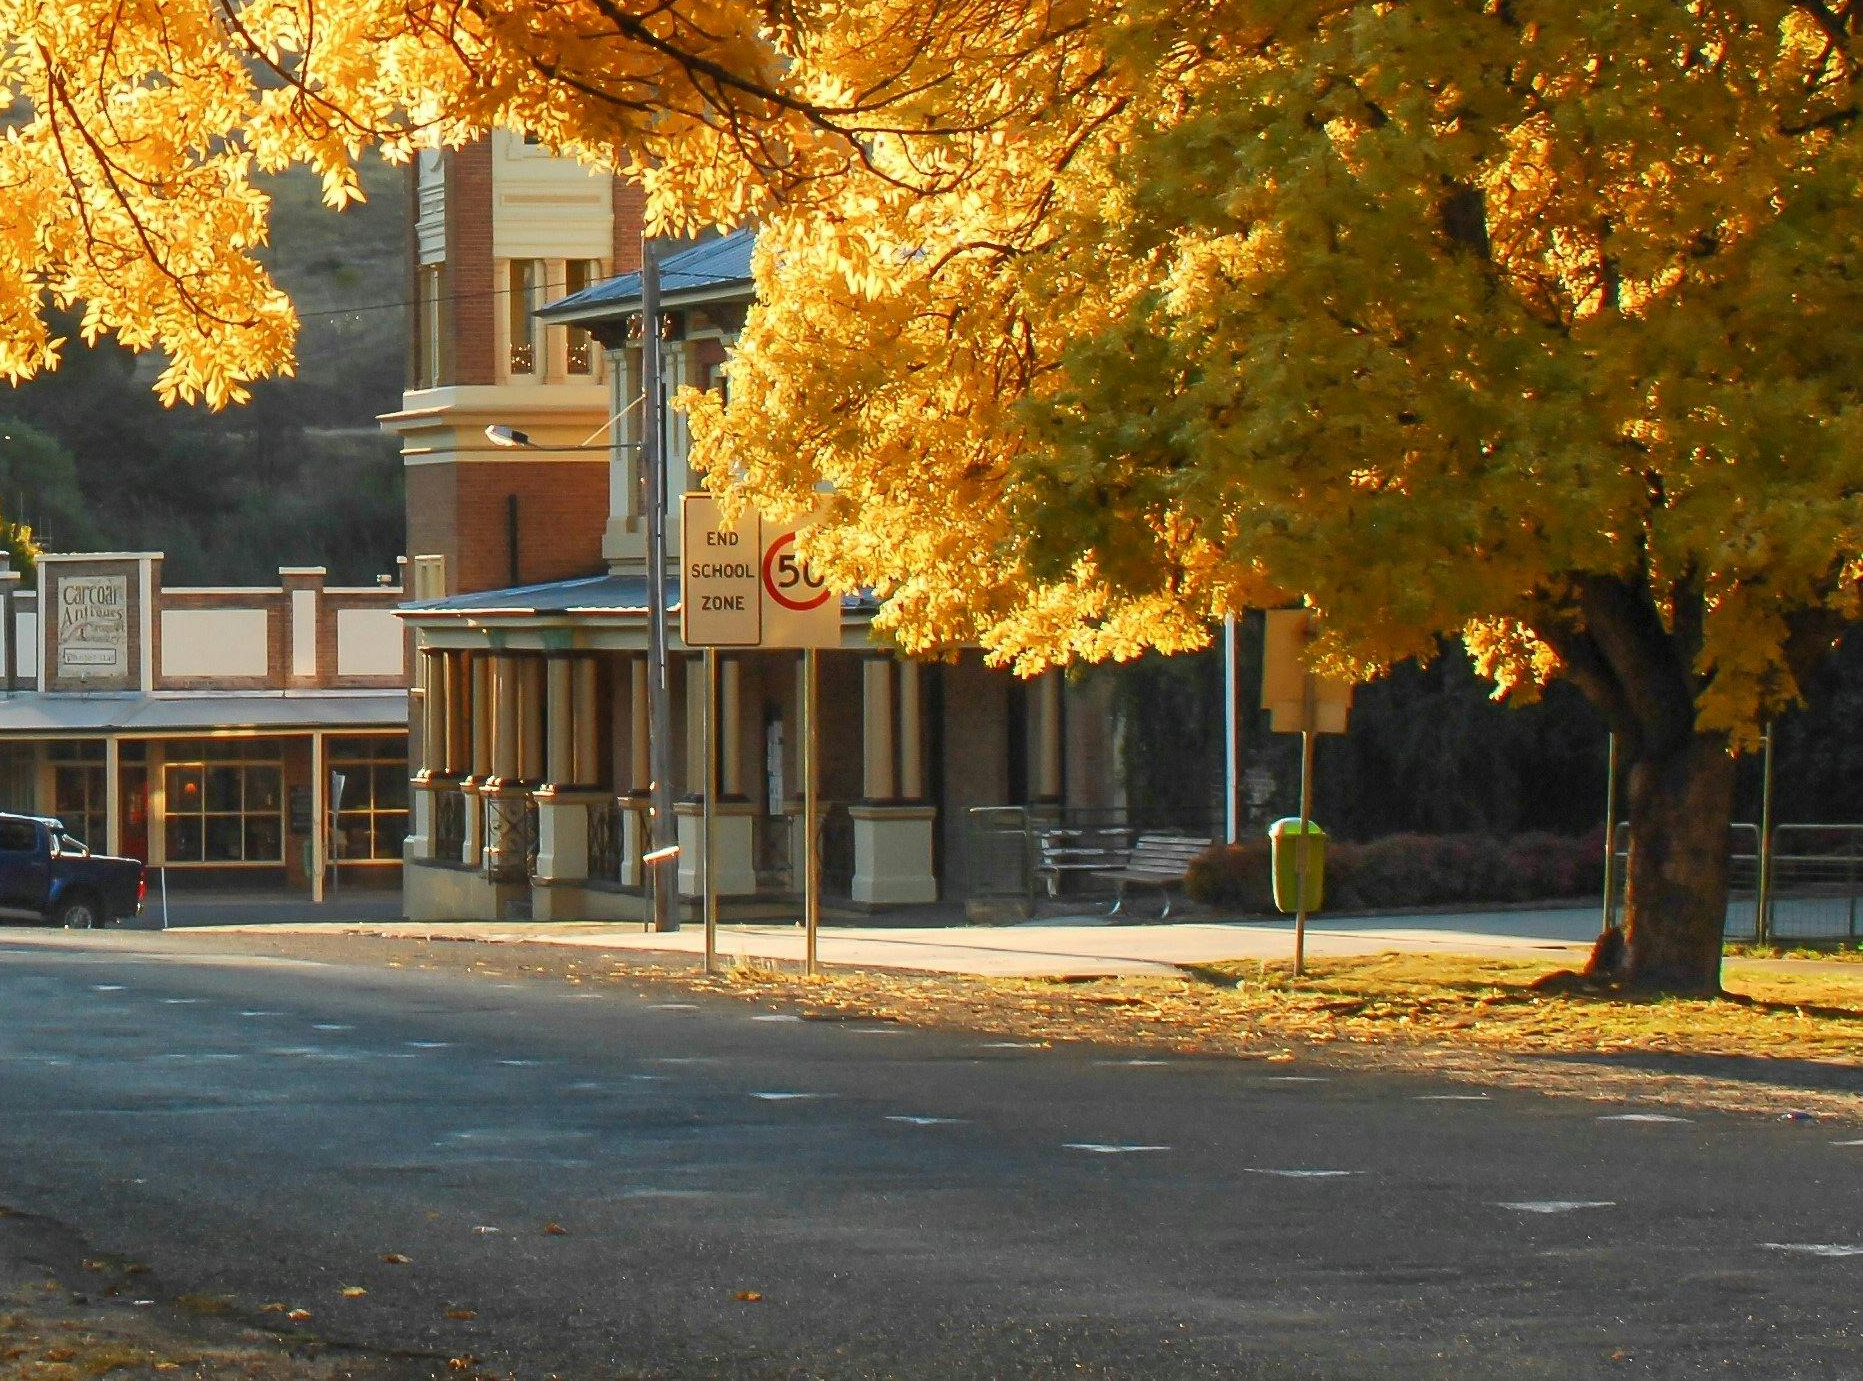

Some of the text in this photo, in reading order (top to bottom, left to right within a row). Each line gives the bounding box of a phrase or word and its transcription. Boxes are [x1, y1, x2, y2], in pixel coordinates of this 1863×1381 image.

[706, 531, 739, 546] END
[691, 563, 755, 579] SCHOOL
[701, 595, 745, 611] ZONE
